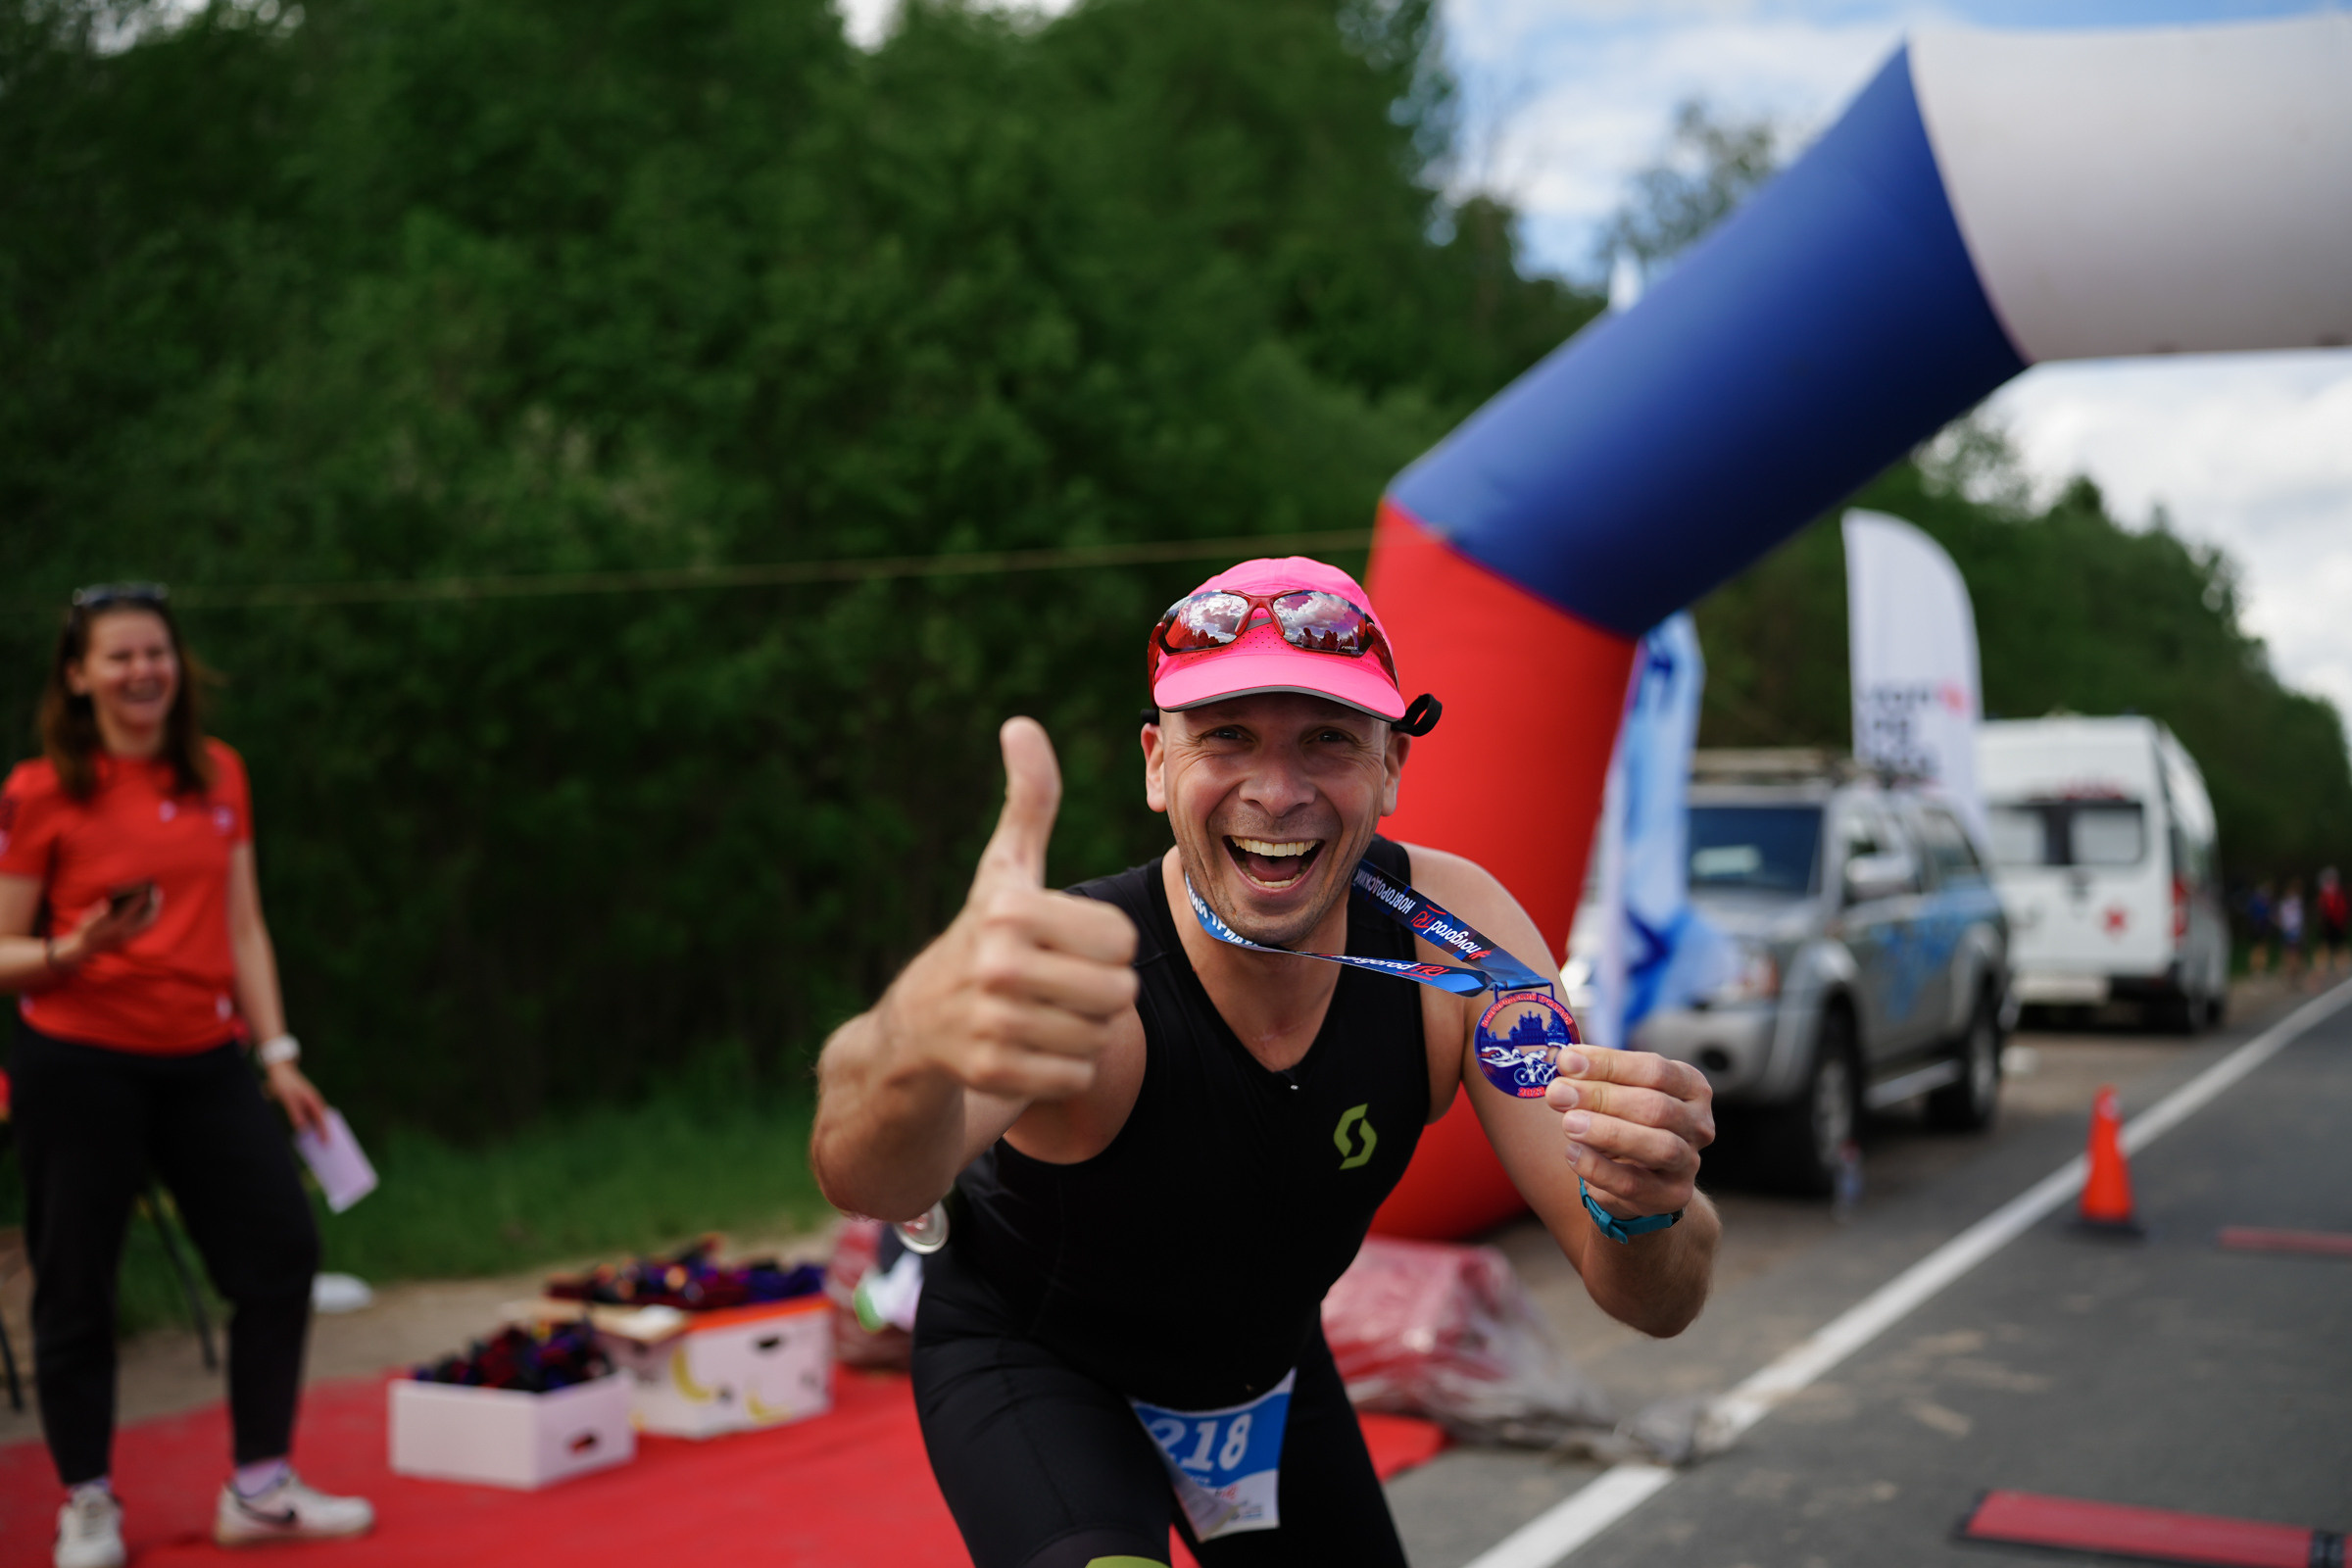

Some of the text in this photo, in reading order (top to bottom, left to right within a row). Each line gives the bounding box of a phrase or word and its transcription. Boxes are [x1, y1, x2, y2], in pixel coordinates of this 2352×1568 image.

[1352, 868, 1417, 914] НОВГОРОДСКИЙ
[1481, 992, 1574, 1028] НОВГОРОДСКИЙ ТРИАТЛОН
[1148, 1413, 1253, 1471] 218
